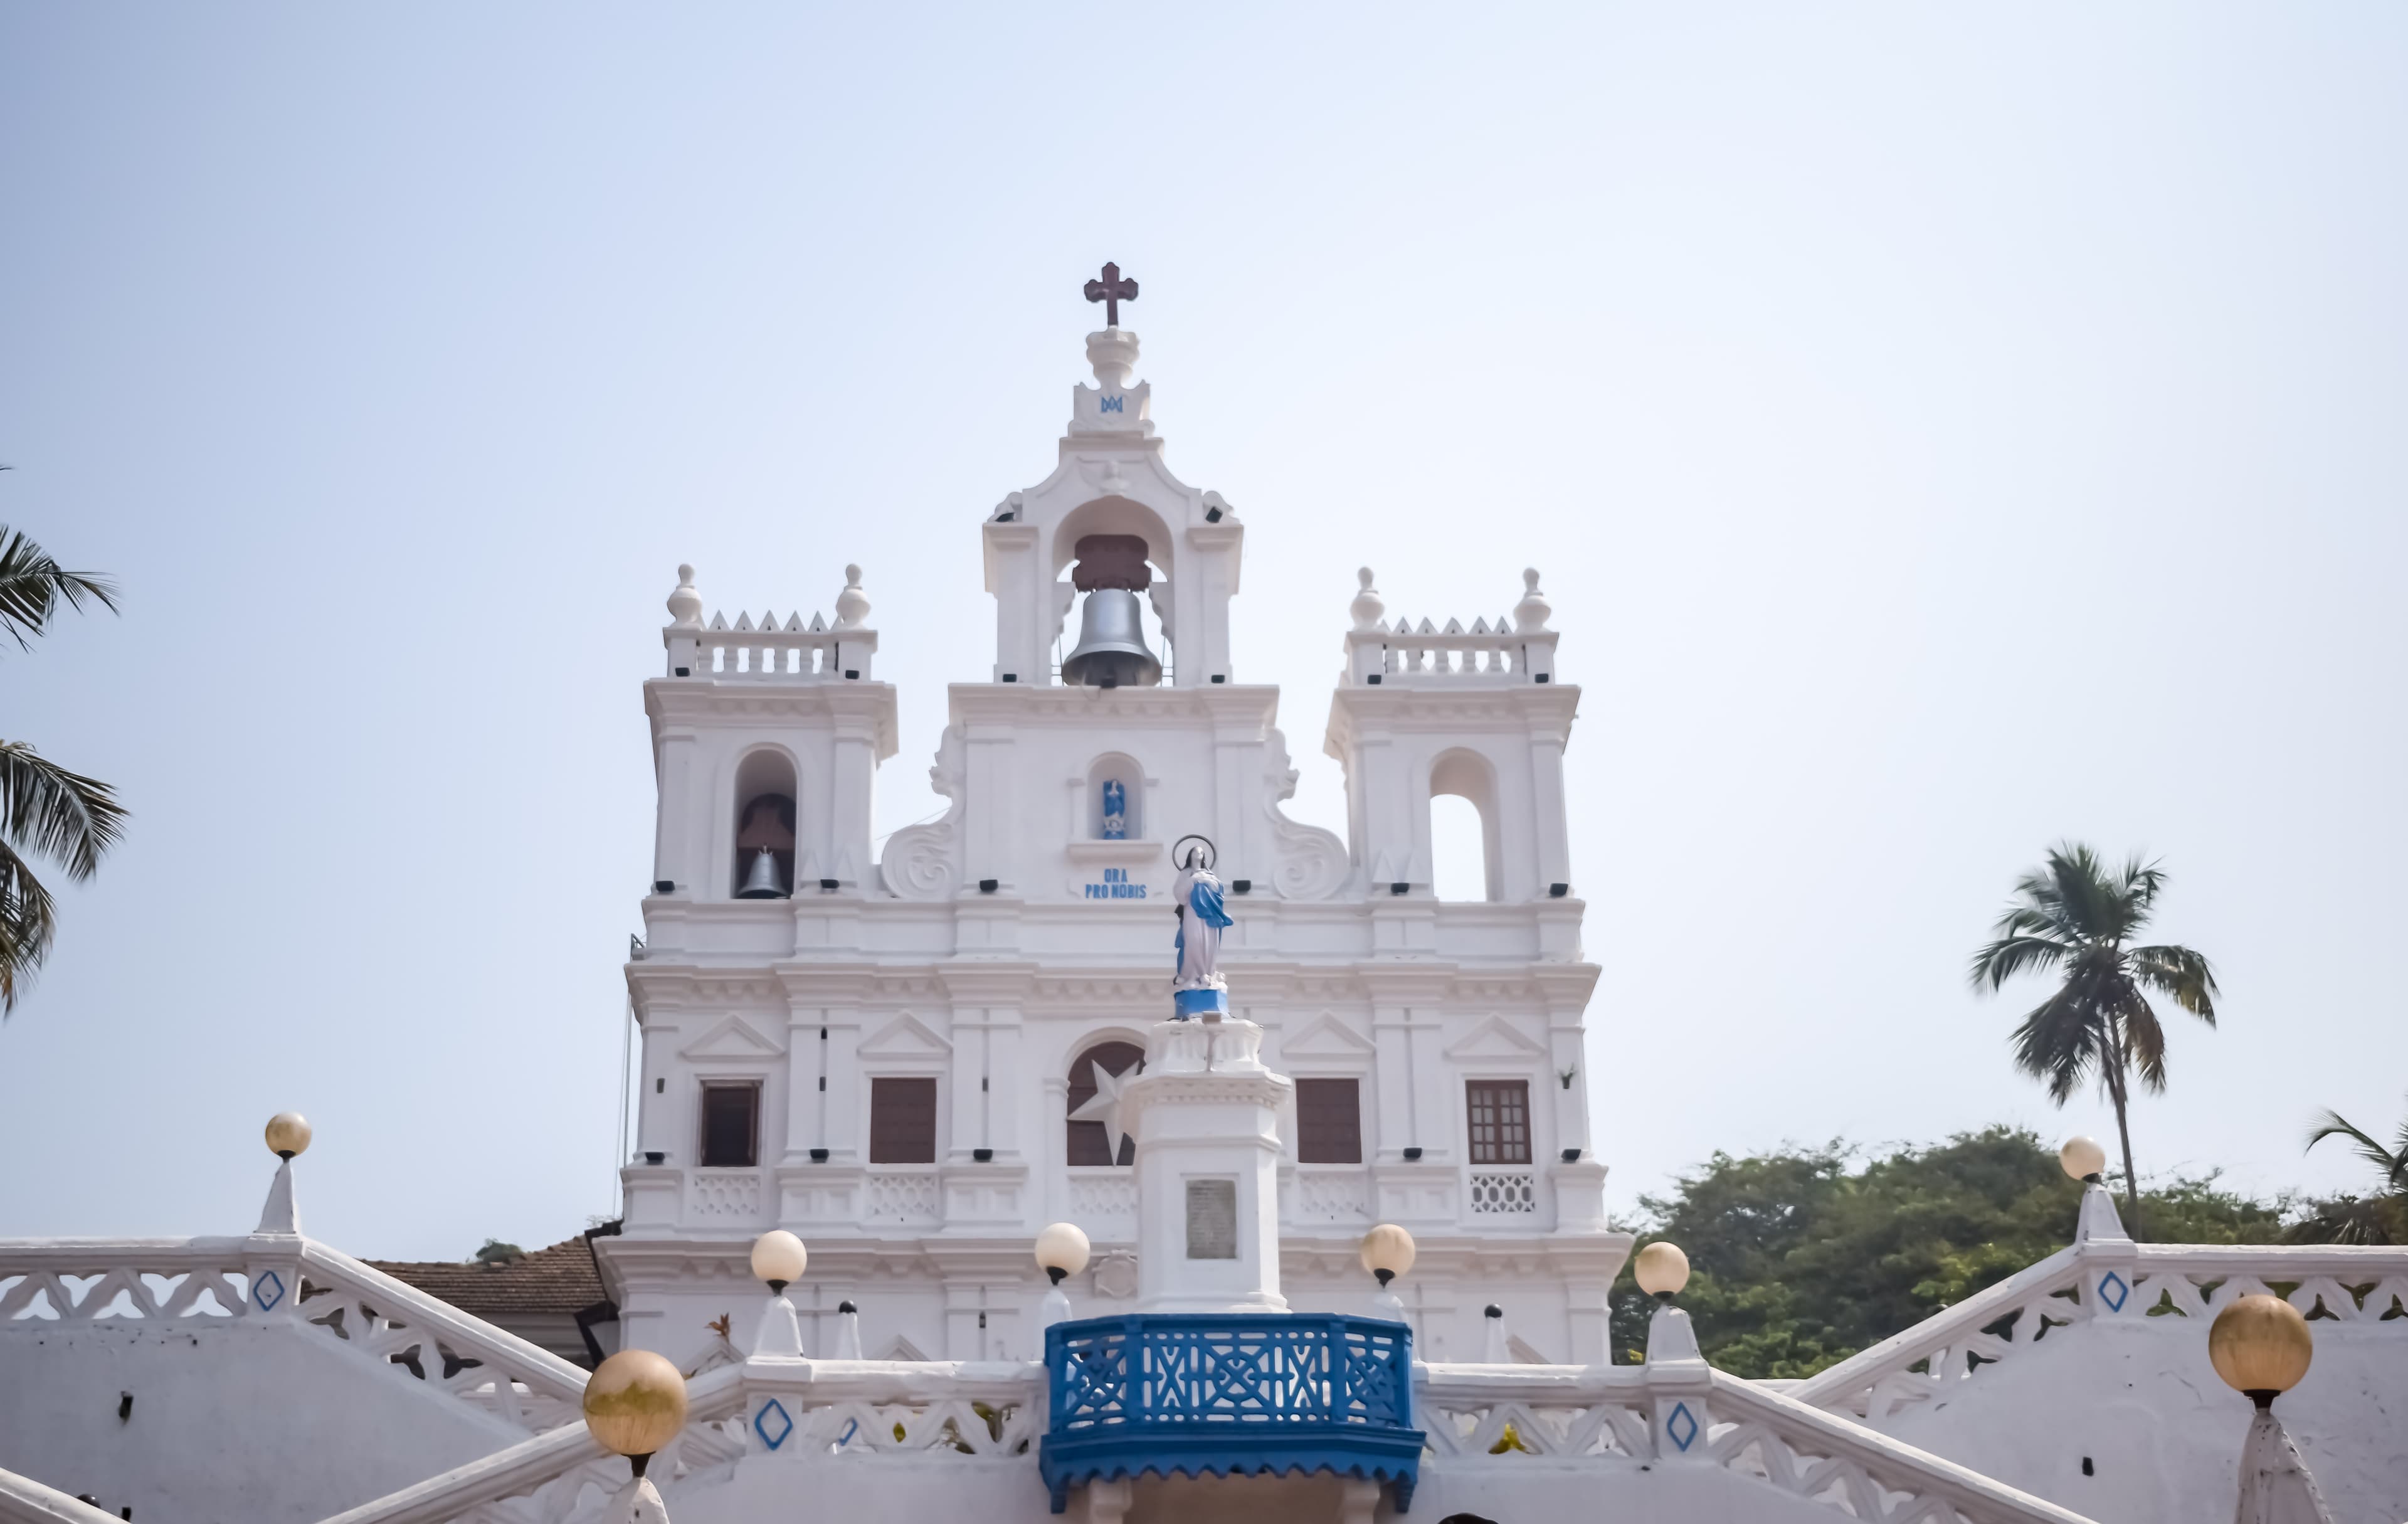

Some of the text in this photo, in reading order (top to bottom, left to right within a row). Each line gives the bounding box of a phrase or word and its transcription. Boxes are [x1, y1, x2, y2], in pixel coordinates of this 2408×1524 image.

[1104, 868, 1127, 883] ORA
[1085, 884, 1146, 899] PRO NOBIS
